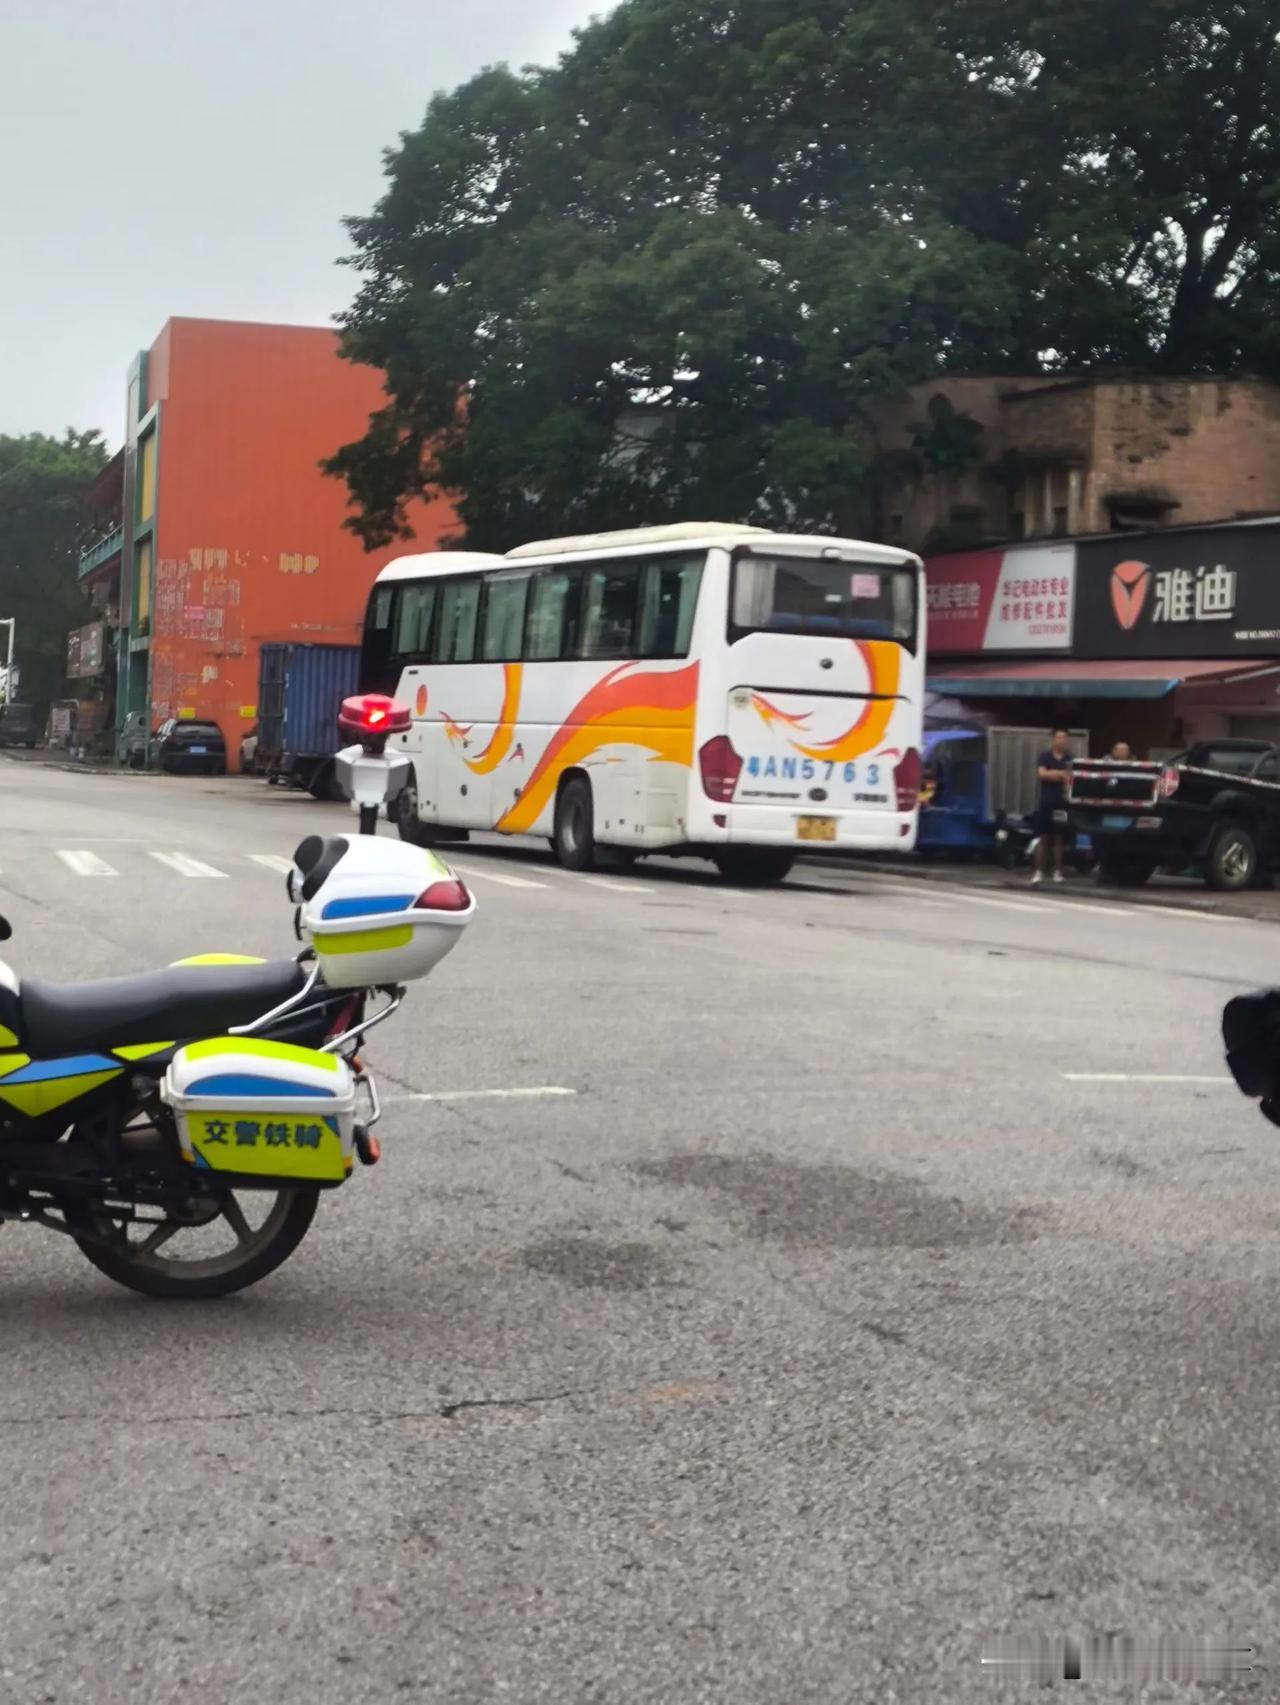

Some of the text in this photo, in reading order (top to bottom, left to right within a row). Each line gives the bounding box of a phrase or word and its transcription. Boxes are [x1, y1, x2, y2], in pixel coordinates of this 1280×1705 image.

[1152, 564, 1237, 623] 雅迪
[203, 1120, 323, 1149] 交警铁骑
